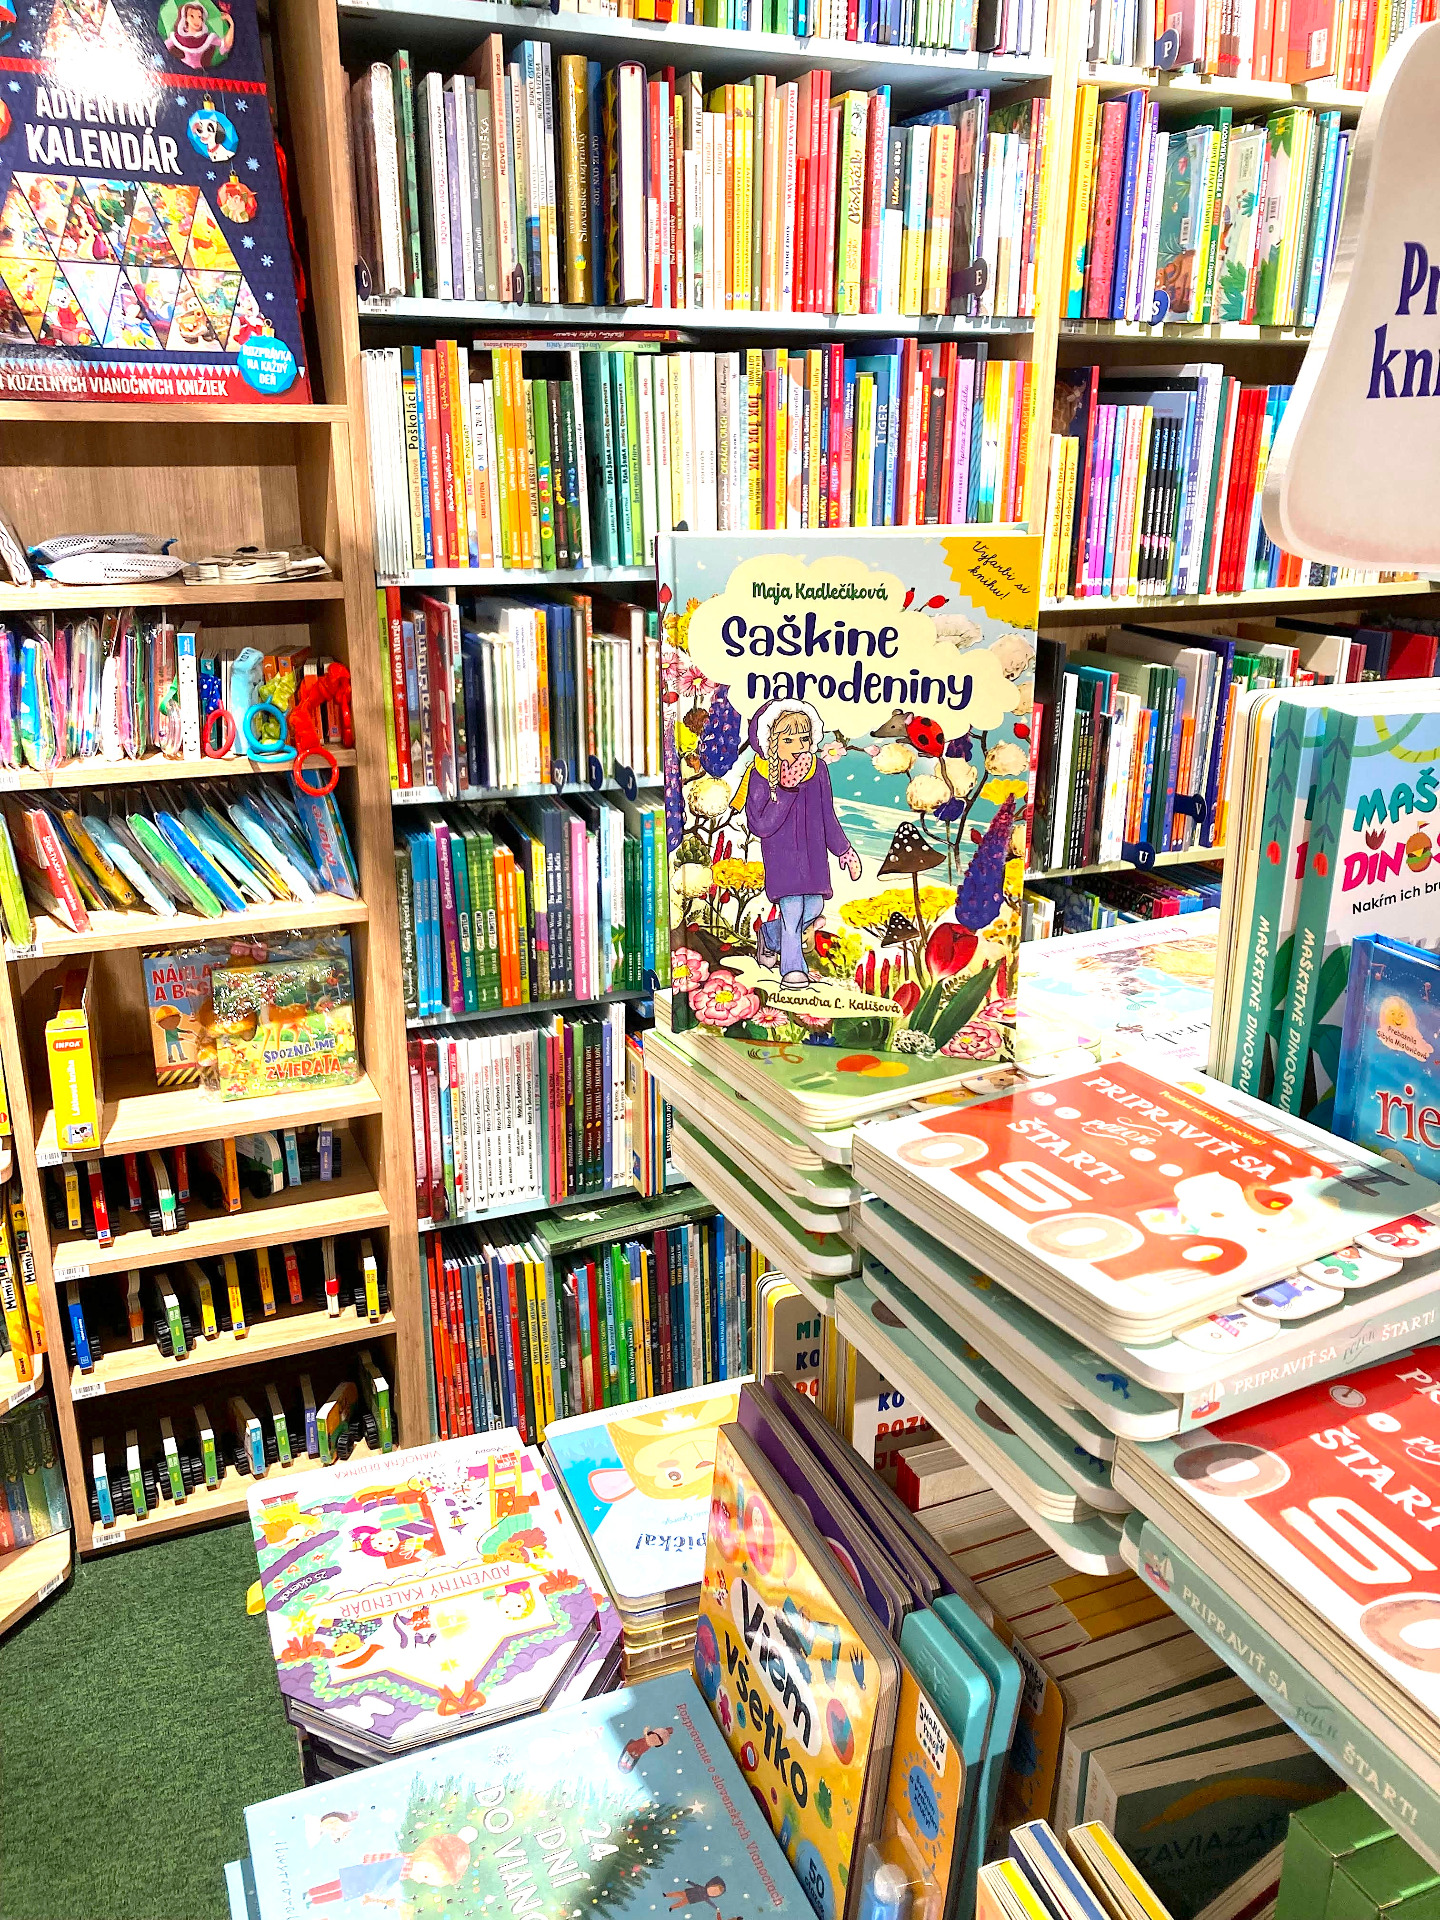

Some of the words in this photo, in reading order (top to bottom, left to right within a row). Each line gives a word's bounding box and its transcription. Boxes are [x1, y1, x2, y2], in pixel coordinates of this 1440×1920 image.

[25, 123, 183, 176] KALENDÁR
[246, 359, 259, 371] NA
[260, 359, 288, 374] KAŽDÝ
[258, 373, 277, 386] DEŇ
[7, 374, 88, 393] KÚZELNÝCH
[90, 374, 173, 396] VIANOČNÝCH
[176, 377, 229, 397] KNIŽIEK
[404, 390, 419, 450] Poškoláci
[875, 403, 889, 448] TIGER
[411, 458, 420, 485] Futová
[1055, 461, 1065, 485] správ
[1067, 461, 1076, 485] správ
[413, 485, 422, 518] Gabriela
[1053, 486, 1064, 521] dobrých
[1064, 486, 1075, 521] dobrých
[1052, 522, 1061, 538] Rok
[1063, 522, 1072, 538] Rok
[968, 566, 1011, 600] knihu!
[973, 541, 1016, 581] Vyfarbi
[1014, 583, 1031, 595] si
[752, 581, 792, 606] Maja
[795, 580, 888, 602] Kadlečíková
[391, 618, 402, 654] Marge
[721, 611, 899, 658] Saškine
[394, 663, 403, 686] Leto
[746, 659, 974, 711] narodeniny
[1352, 893, 1398, 915] Nakŕm
[1400, 886, 1421, 903] ich
[1246, 914, 1271, 1013] MAŠKRTNÉ
[1290, 927, 1316, 1027] MAŠKRTNÉ
[155, 989, 168, 1002] A
[766, 990, 831, 1010] Alexandra
[834, 996, 845, 1010] L.
[848, 998, 901, 1016] Kališová
[55, 1039, 82, 1050] INFOA
[263, 1037, 337, 1064] SPOZNAJME
[66, 1059, 77, 1083] kniha
[69, 1084, 81, 1117] Látková
[1081, 1076, 1244, 1157] PRIPRAVIŤ
[1229, 1155, 1277, 1181] SA
[1006, 1115, 1126, 1188] ŠTART!
[23, 1257, 36, 1284] Mimi
[3, 1284, 18, 1311] Mimi
[1233, 1350, 1318, 1396] PRIPRAVIŤ
[1320, 1346, 1337, 1363] SA
[1380, 1309, 1437, 1342] ŠTART!
[332, 1458, 381, 1481] DEDINKA
[428, 1564, 511, 1601] ADVENTNÝ
[338, 1585, 424, 1619] KALENDÁR
[740, 1578, 812, 1751] Viem
[724, 1630, 808, 1810] všetko
[1182, 1585, 1267, 1675] PRIPRAVIŤ
[1268, 1669, 1290, 1701] SA
[1343, 1740, 1419, 1828] ŠTART!
[474, 1784, 515, 1835] DO
[676, 1702, 713, 1766] Rozprávanie
[711, 1775, 751, 1842] slovenských
[745, 1840, 784, 1907] Vianociach
[533, 1826, 591, 1889] DNÍ
[579, 1820, 620, 1863] 24
[810, 1857, 826, 1900] 50
